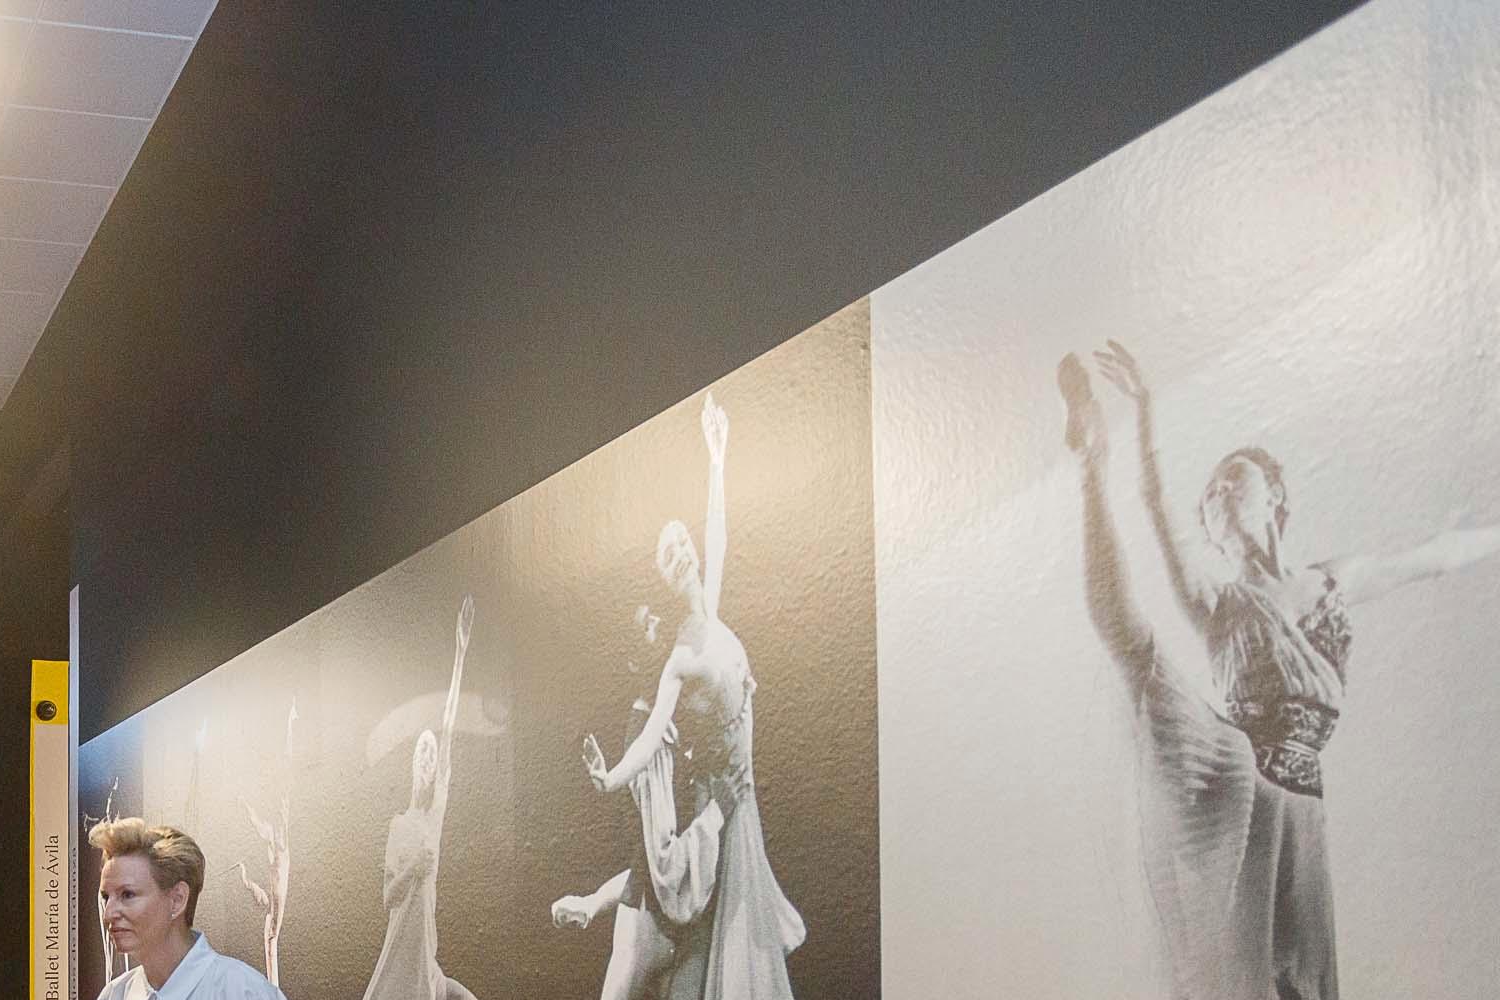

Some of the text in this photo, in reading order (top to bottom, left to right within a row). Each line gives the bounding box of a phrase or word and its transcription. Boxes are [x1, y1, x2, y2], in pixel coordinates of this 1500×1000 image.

[41, 834, 59, 876] Ávila
[45, 880, 59, 900] de
[45, 903, 59, 951] María
[45, 954, 59, 1000] Ballet
